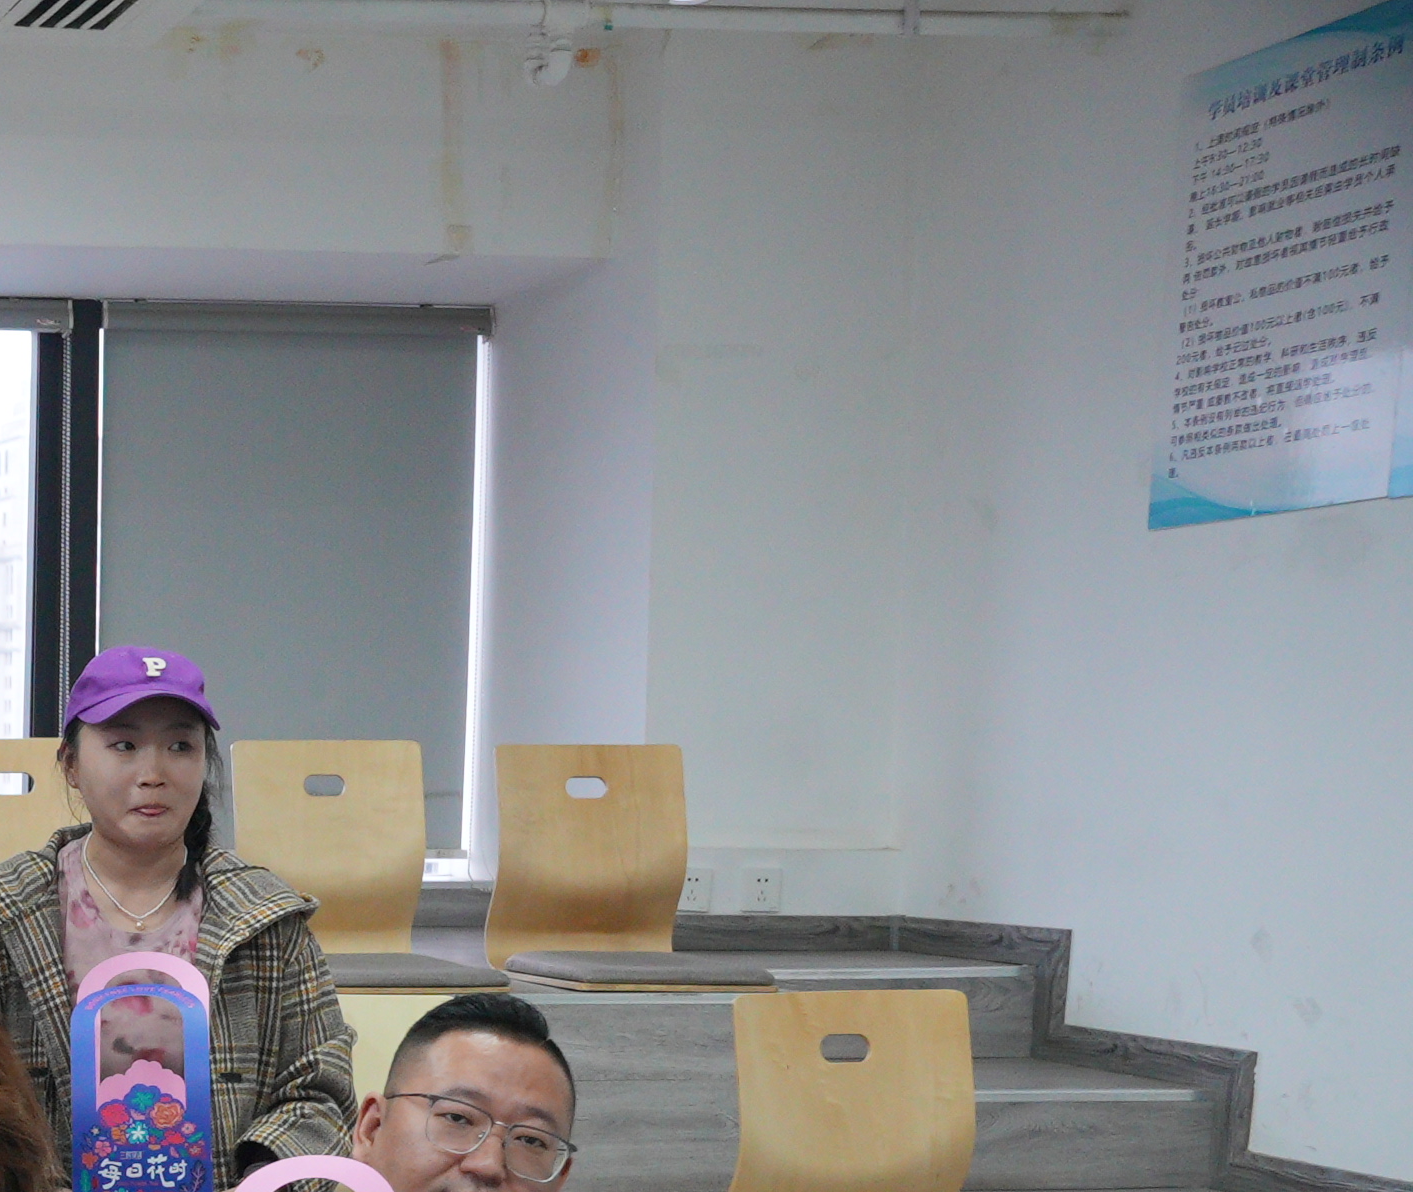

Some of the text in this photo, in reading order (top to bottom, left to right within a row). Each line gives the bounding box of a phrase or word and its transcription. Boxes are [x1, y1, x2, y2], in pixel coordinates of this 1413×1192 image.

[142, 656, 167, 677] P
[97, 1153, 188, 1190] 每日花时
